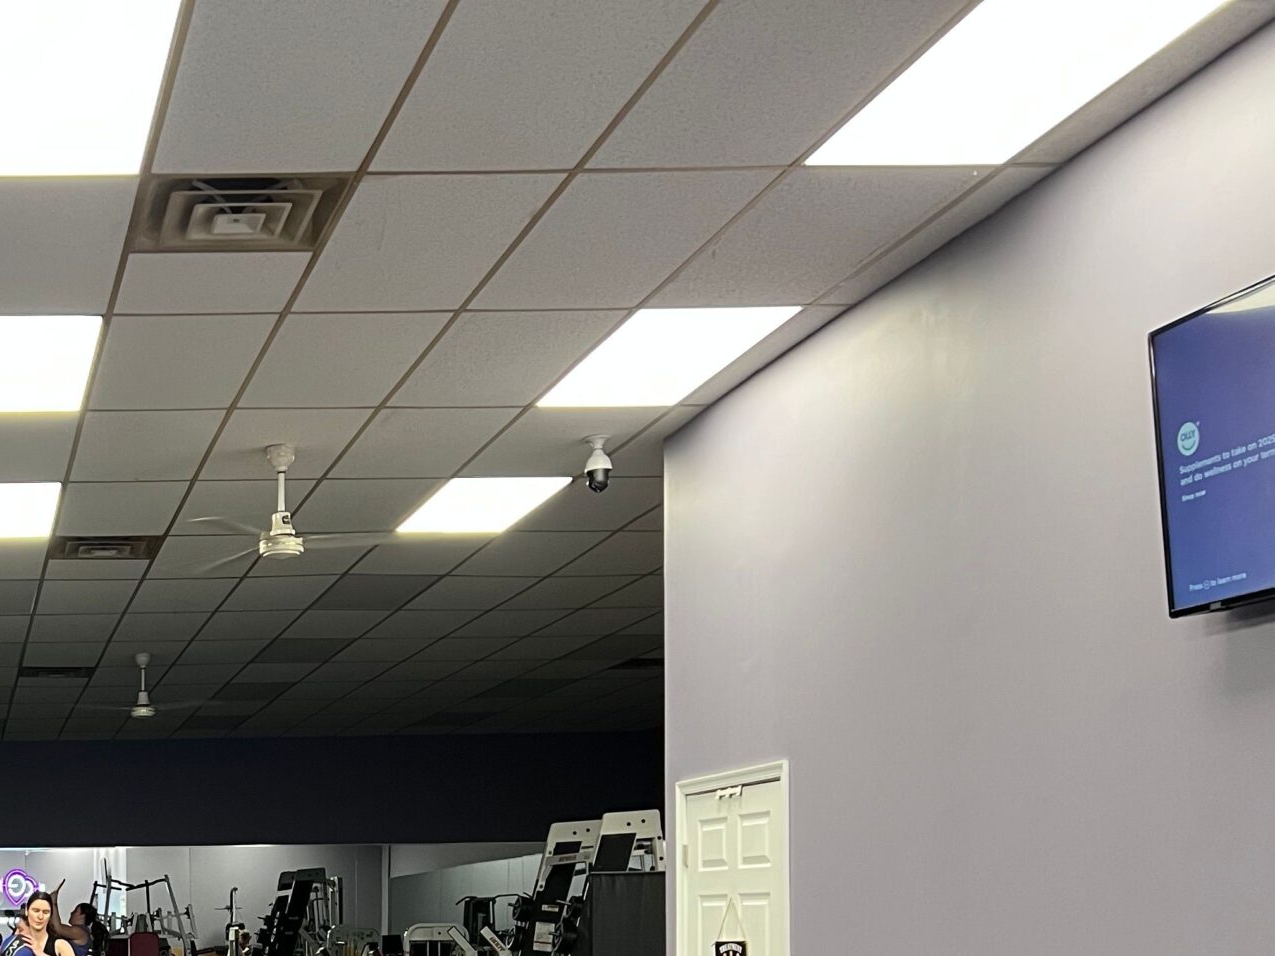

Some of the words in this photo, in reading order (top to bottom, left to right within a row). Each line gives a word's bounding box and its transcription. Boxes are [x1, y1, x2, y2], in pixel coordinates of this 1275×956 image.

[1181, 430, 1195, 441] OLLY
[1179, 455, 1221, 474] Supplements
[1222, 452, 1230, 460] to
[1230, 446, 1246, 457] take
[1247, 442, 1257, 451] on
[1180, 474, 1193, 486] and
[1193, 473, 1203, 482] do
[1204, 463, 1232, 478] wellness
[1232, 460, 1242, 469] on
[1243, 454, 1259, 467] your
[1189, 583, 1203, 592] Press
[1217, 576, 1231, 585] learn
